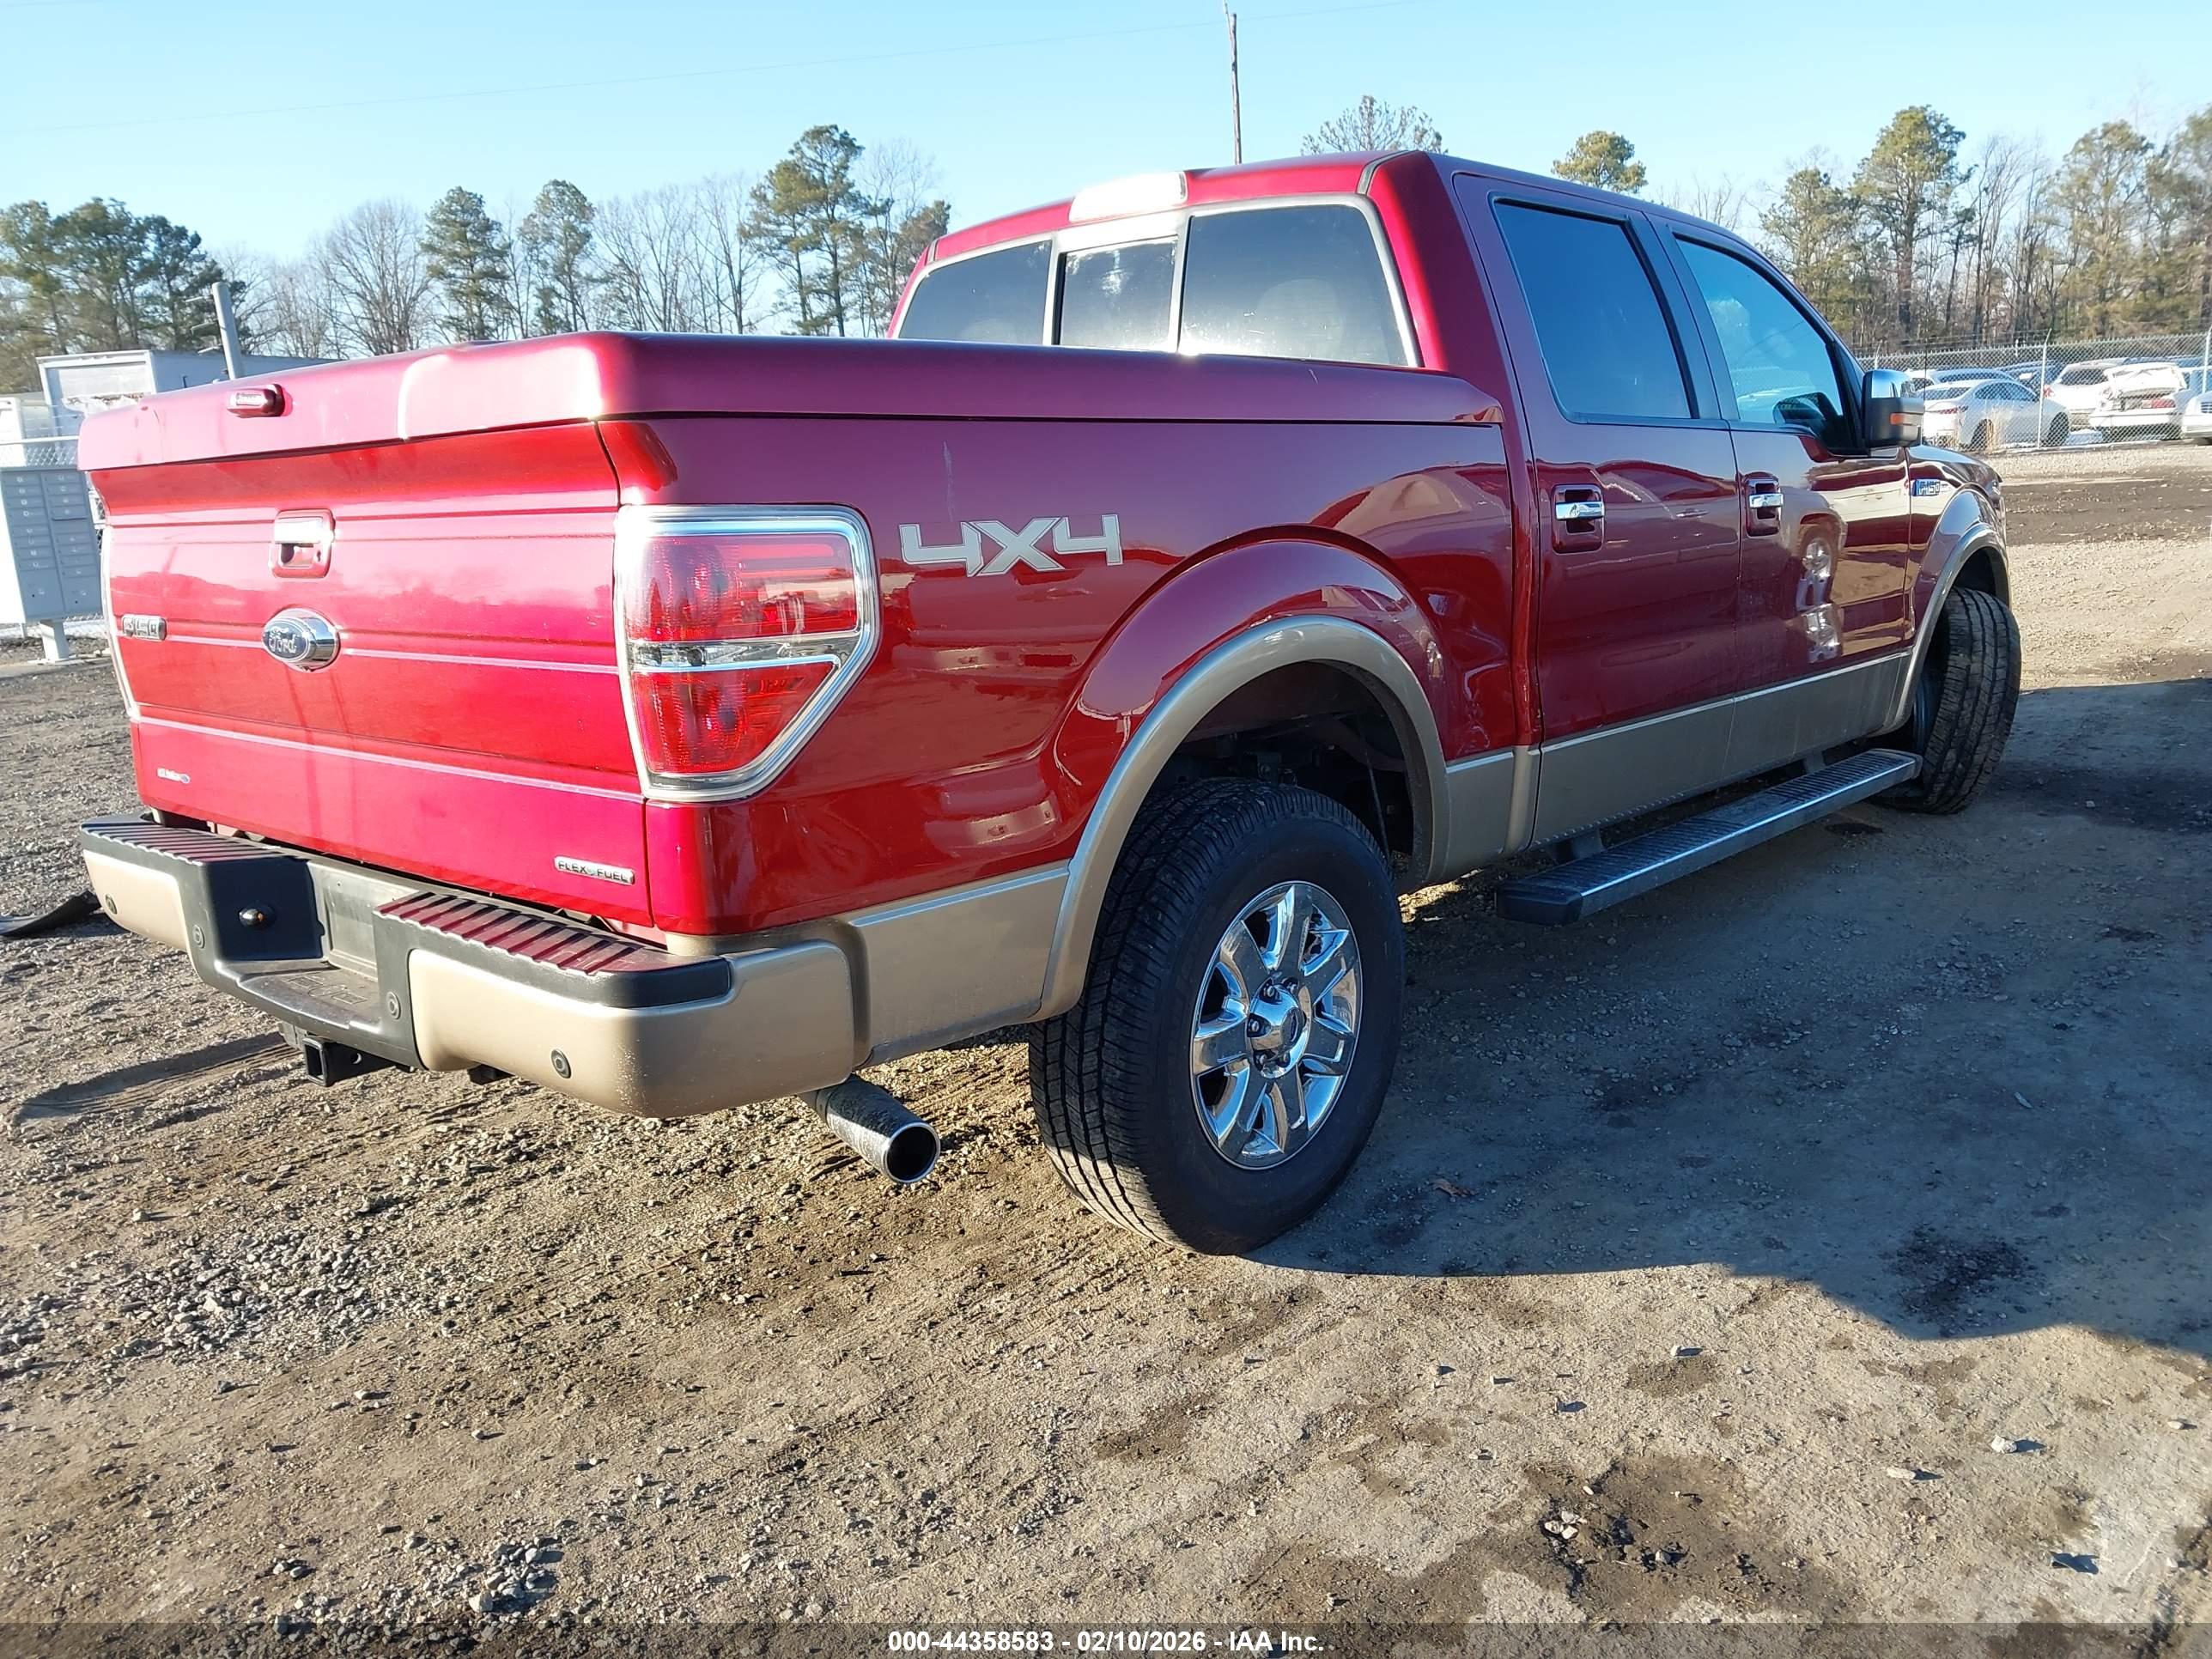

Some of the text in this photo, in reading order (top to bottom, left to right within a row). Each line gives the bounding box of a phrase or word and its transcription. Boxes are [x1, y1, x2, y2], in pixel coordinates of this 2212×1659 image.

[268, 626, 297, 654] Ford
[558, 860, 629, 883] FLEX FUEL
